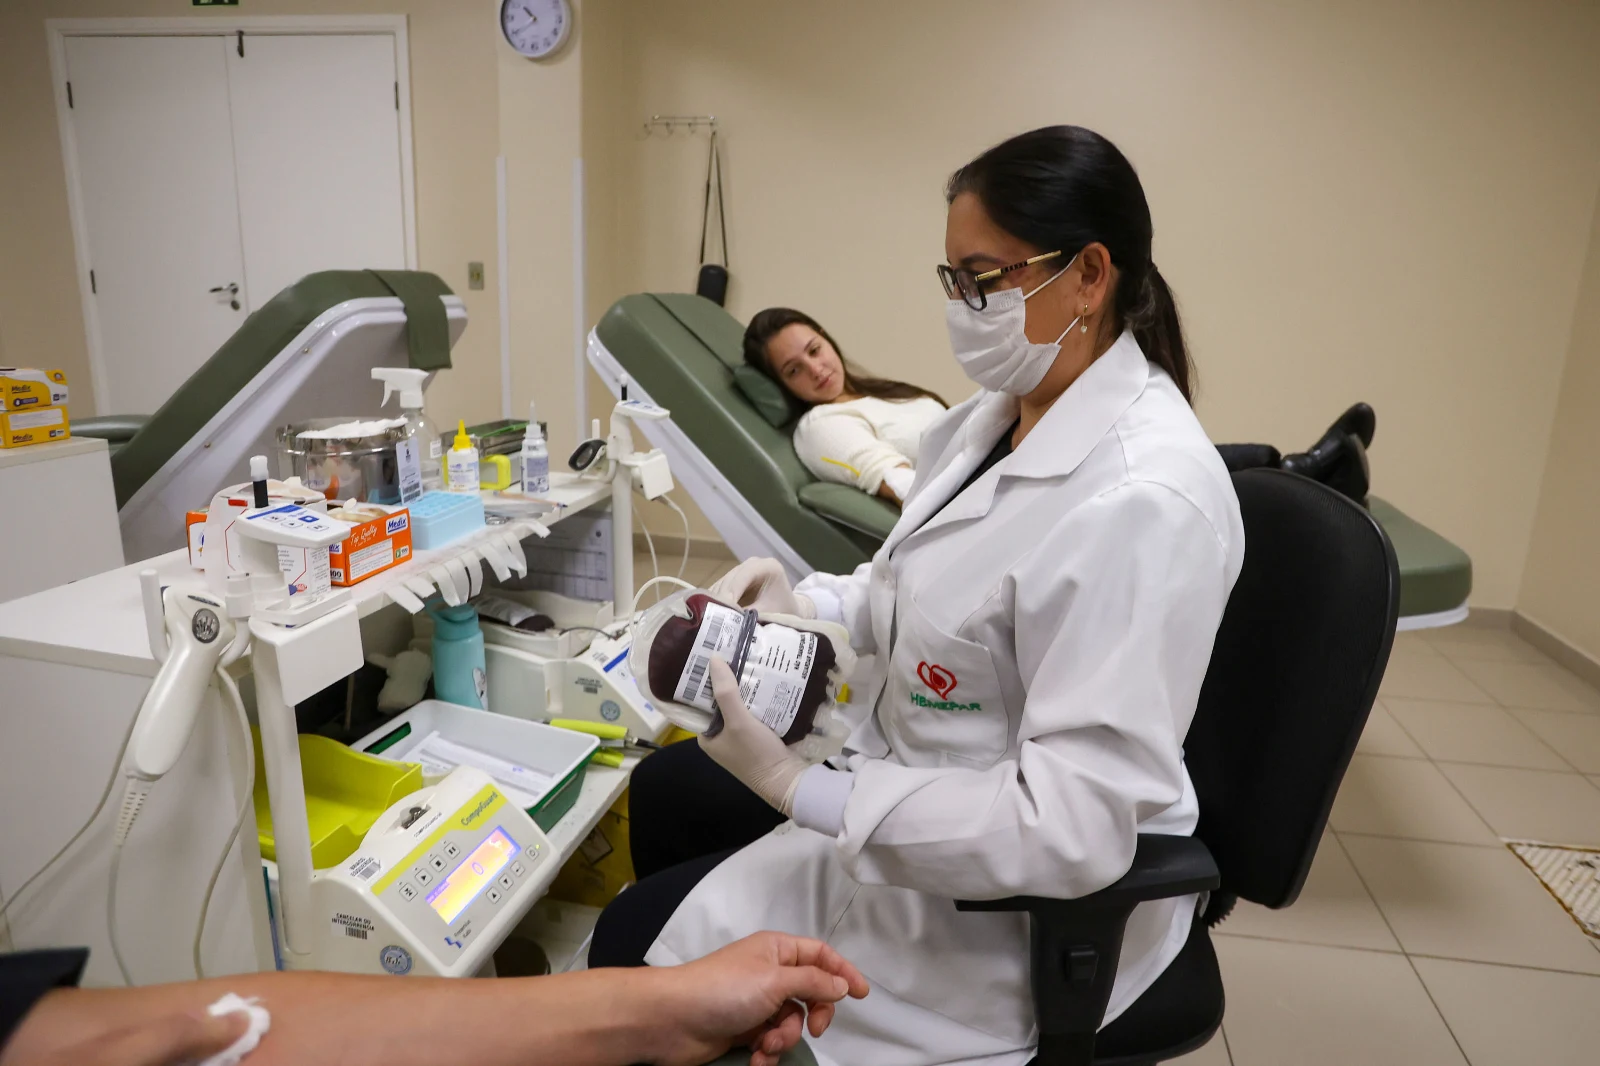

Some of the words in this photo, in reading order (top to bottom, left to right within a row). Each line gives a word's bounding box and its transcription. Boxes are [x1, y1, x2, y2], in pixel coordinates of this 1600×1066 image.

[350, 532, 360, 547] Top
[361, 524, 378, 541] Quality
[387, 517, 407, 533] Medix
[461, 791, 498, 826] CompoGuard
